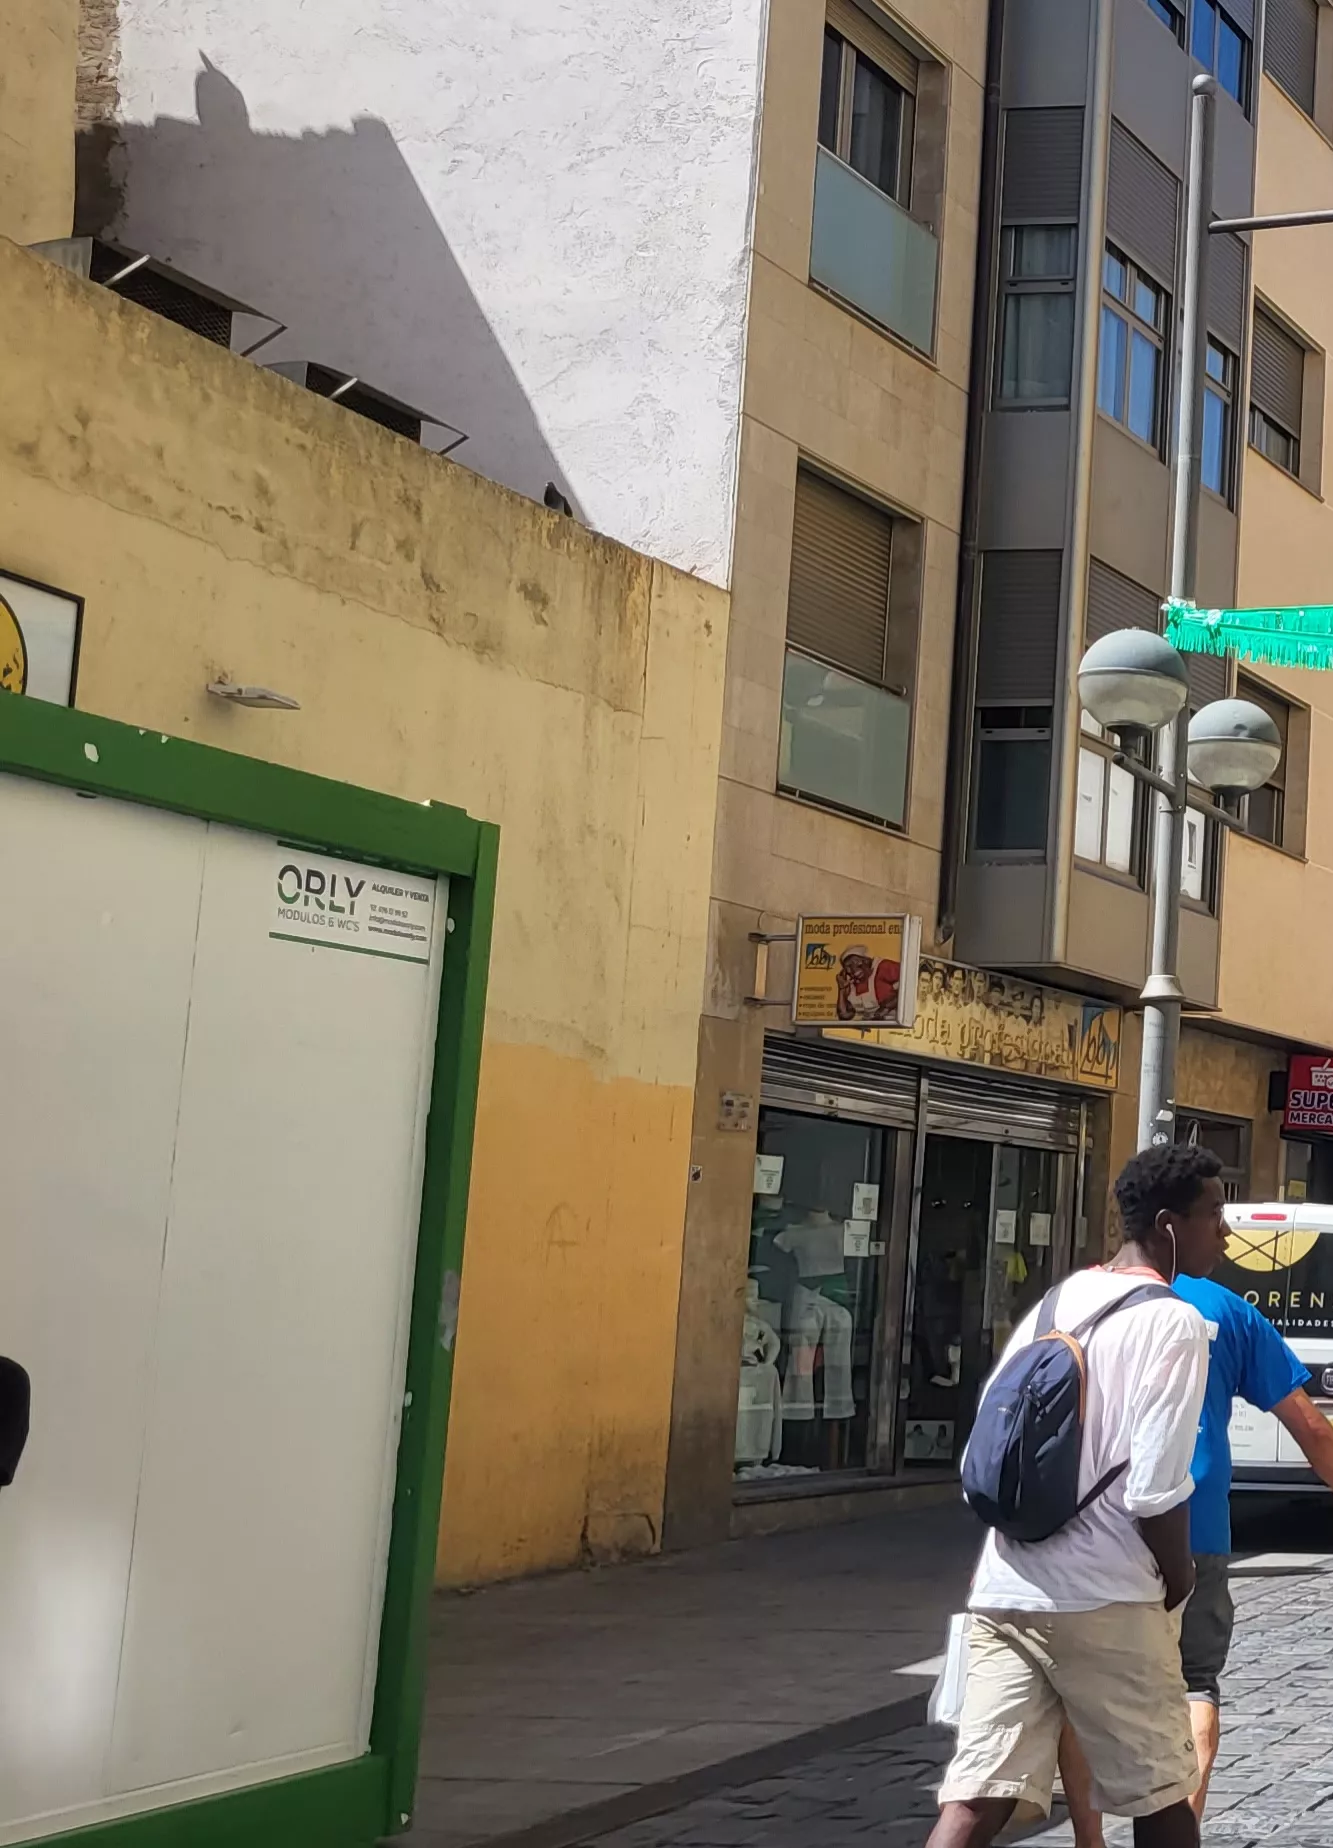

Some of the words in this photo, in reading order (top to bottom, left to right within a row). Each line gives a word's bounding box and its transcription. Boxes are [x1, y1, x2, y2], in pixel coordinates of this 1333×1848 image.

[278, 865, 366, 915] ORLY
[277, 907, 326, 926] MODULOS
[328, 916, 335, 926] &
[804, 922, 830, 935] moda
[833, 921, 886, 937] profesional
